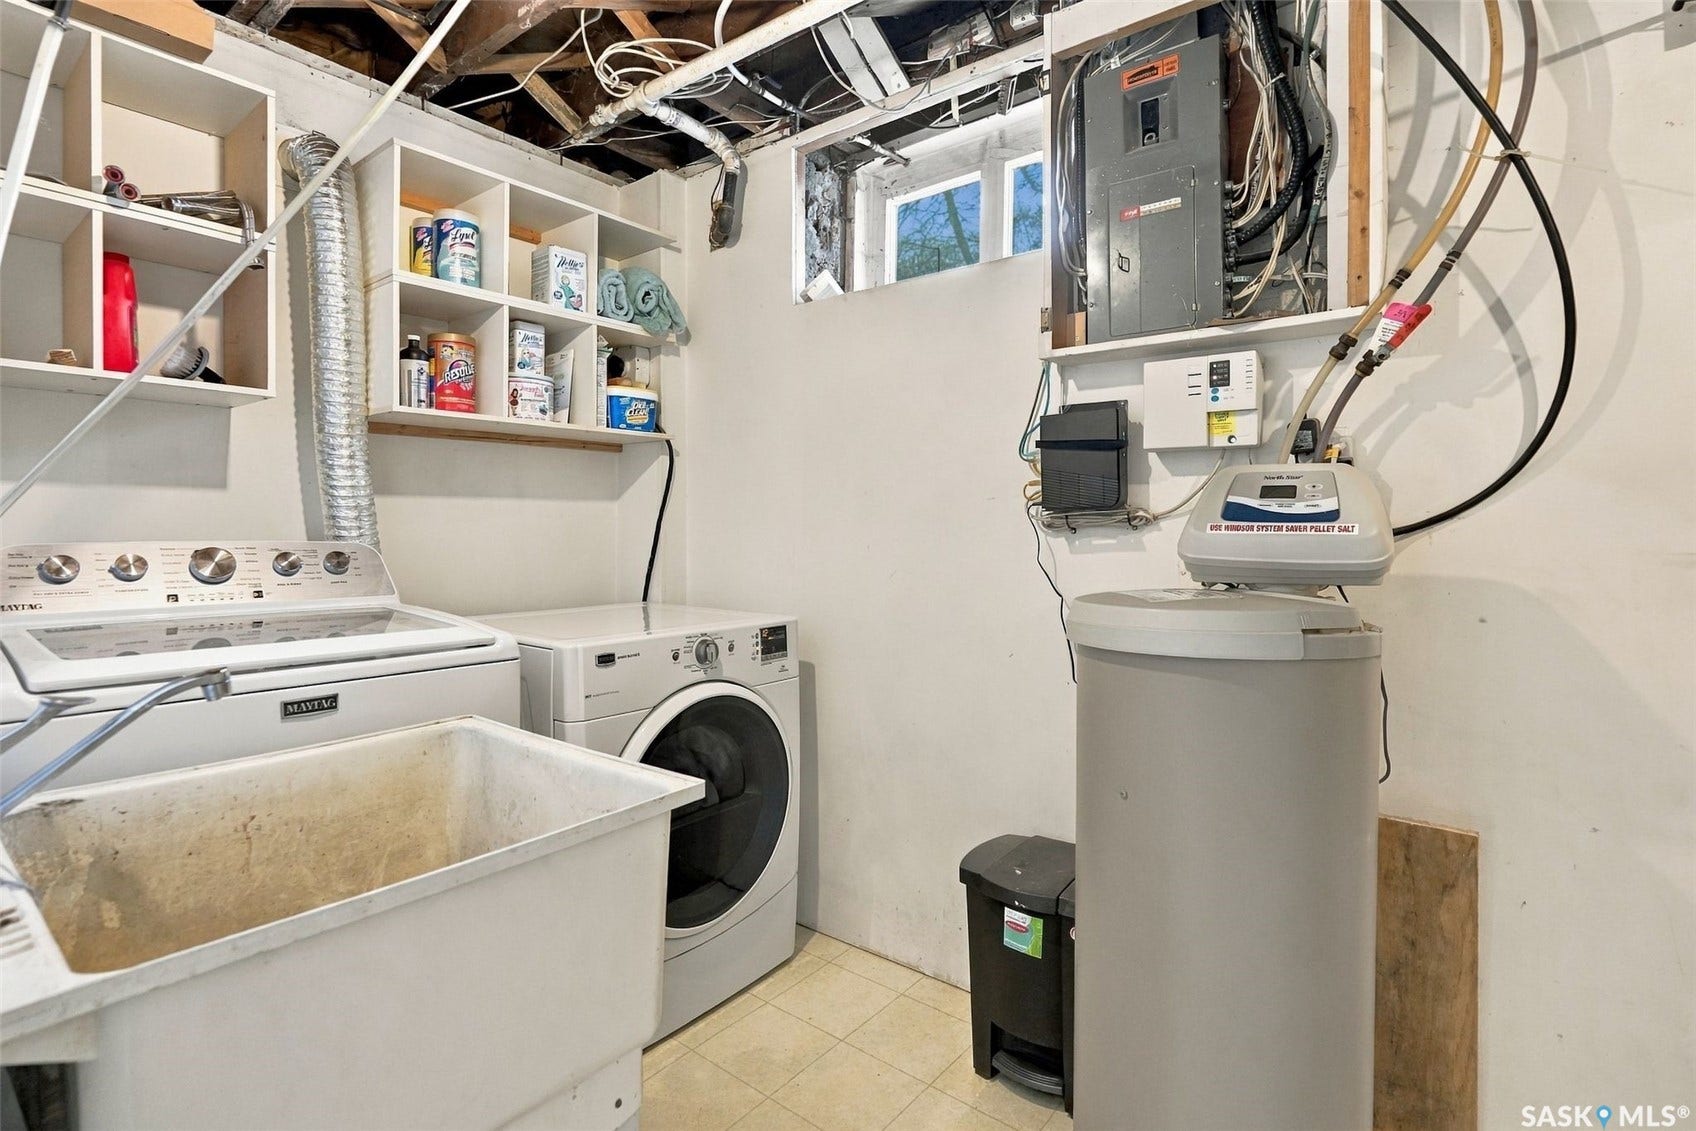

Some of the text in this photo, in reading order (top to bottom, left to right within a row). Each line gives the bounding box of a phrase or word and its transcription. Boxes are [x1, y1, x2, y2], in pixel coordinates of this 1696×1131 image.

[451, 229, 476, 242] Lysol
[1224, 524, 1254, 532] WINDSOR
[1310, 525, 1335, 533] PELLET
[1338, 525, 1355, 533] SALT
[286, 698, 336, 714] MAYTAG
